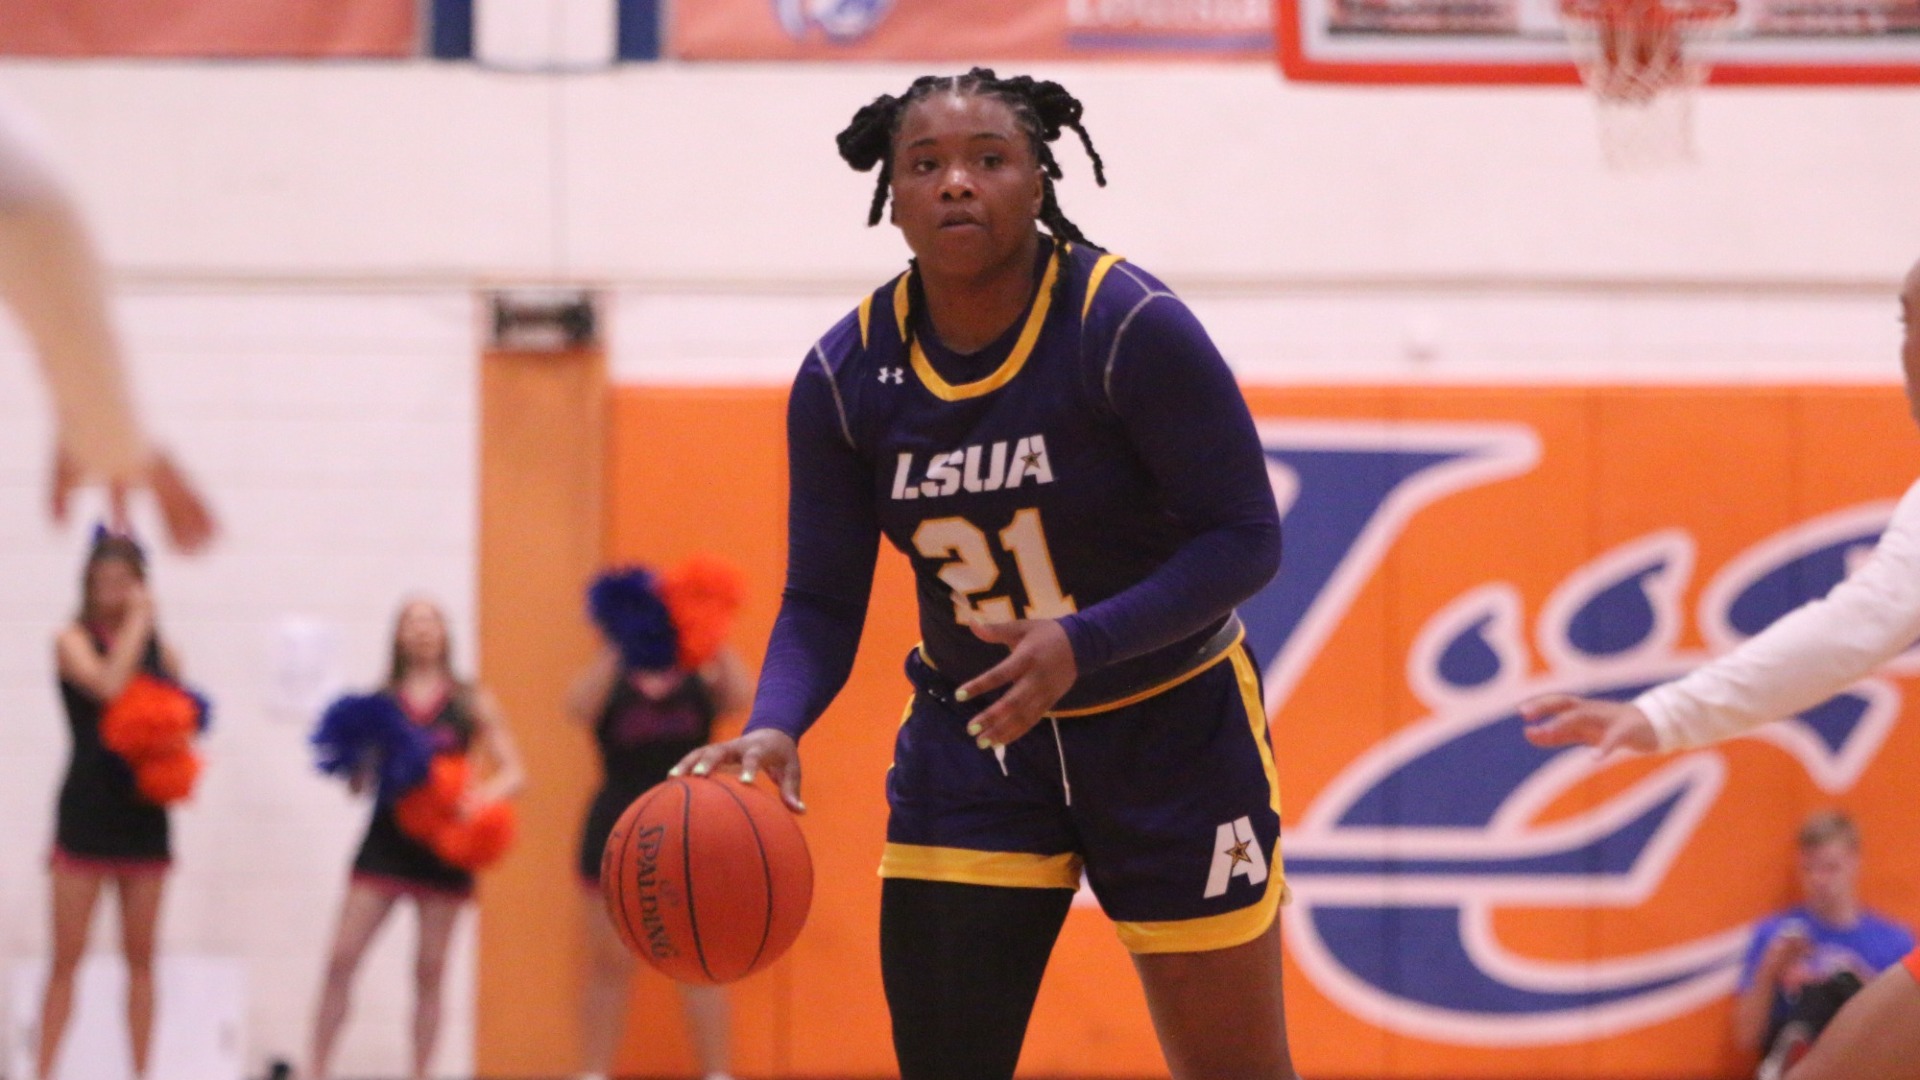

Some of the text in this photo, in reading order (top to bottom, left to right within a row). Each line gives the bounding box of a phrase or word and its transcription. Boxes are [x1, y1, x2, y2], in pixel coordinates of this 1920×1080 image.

[890, 433, 1055, 500] LSUA
[911, 507, 1078, 626] 21
[637, 825, 673, 959] SPALDING
[1203, 815, 1268, 899] A
